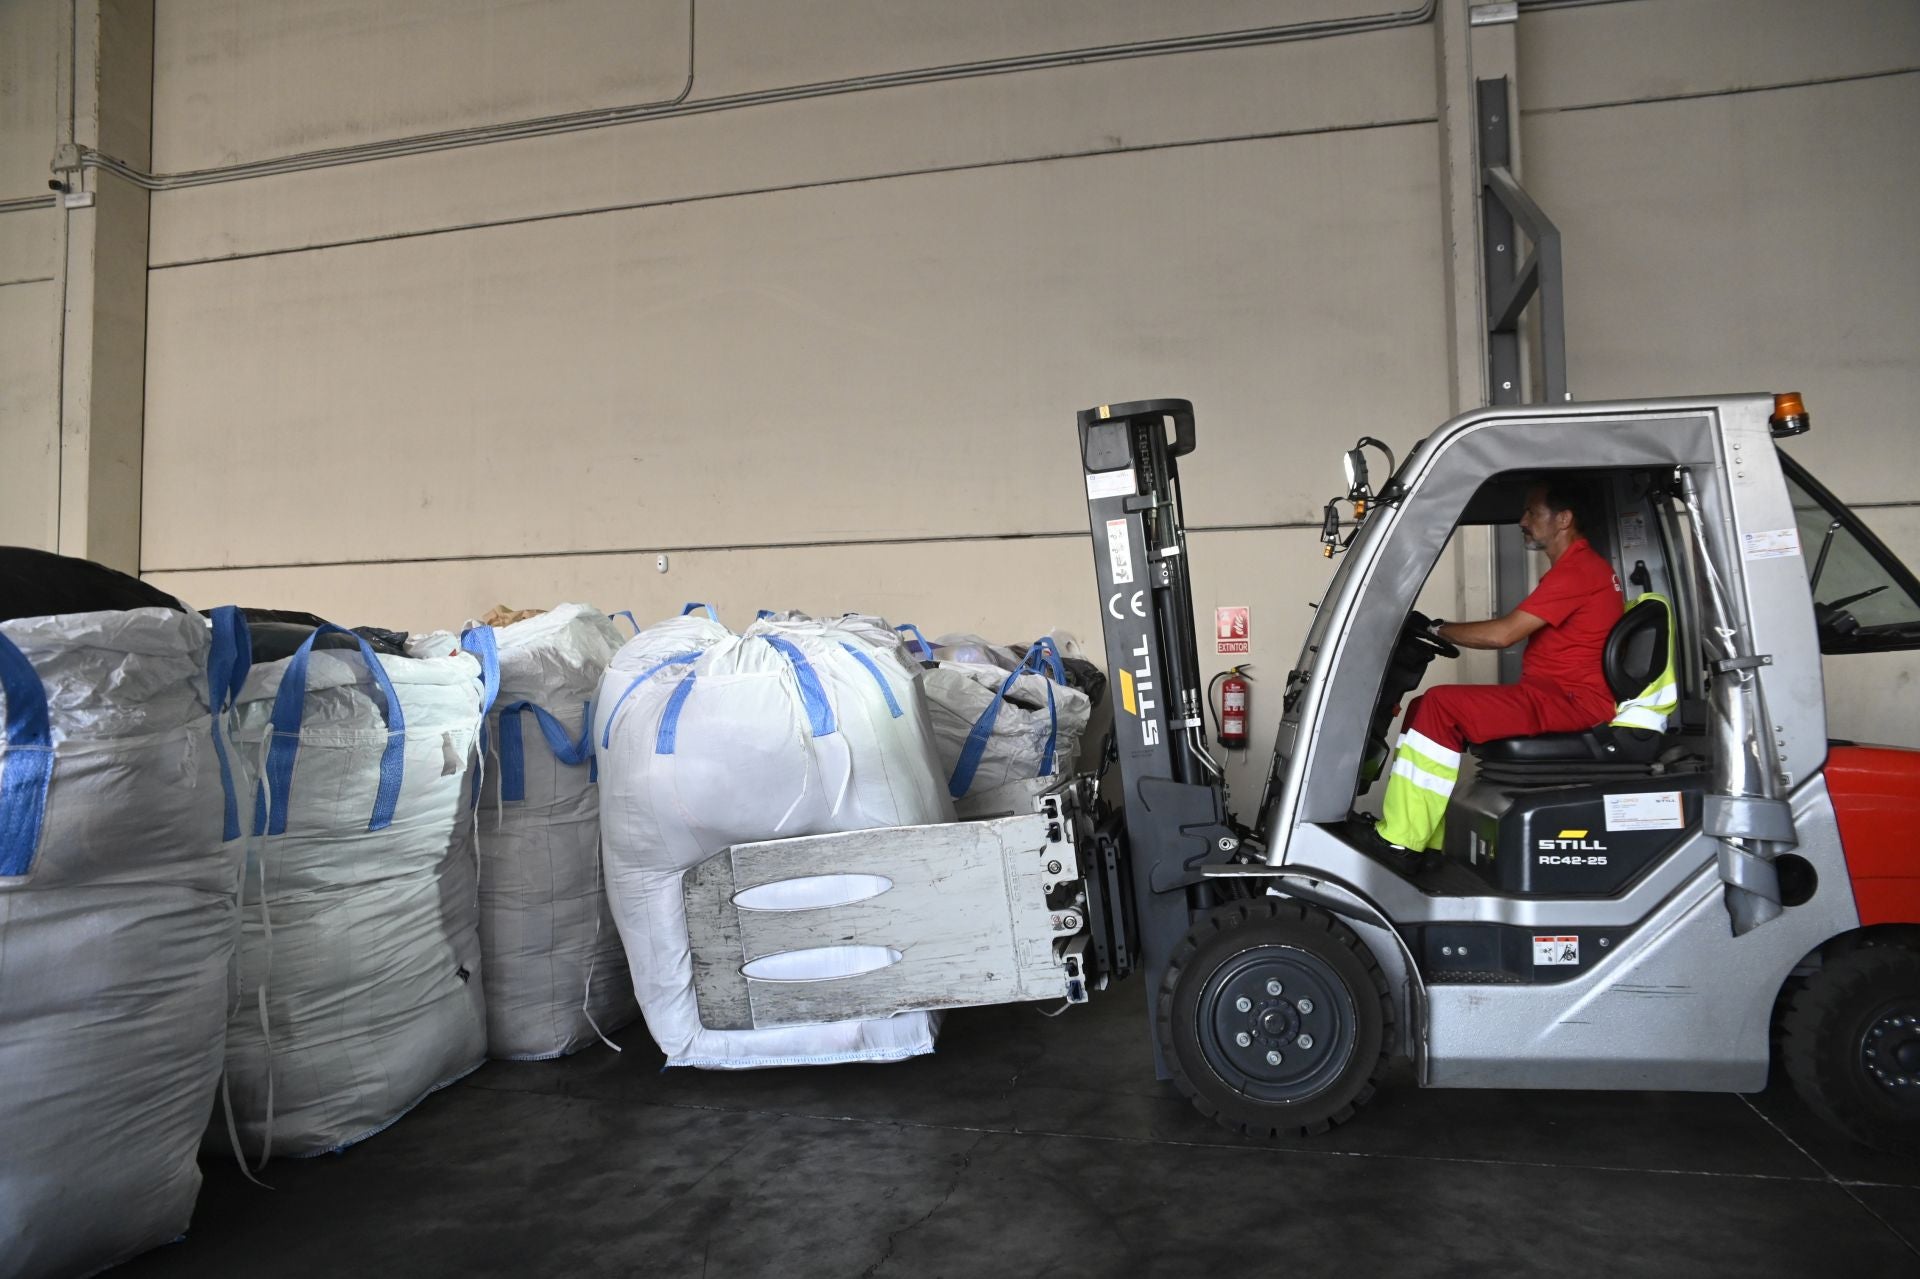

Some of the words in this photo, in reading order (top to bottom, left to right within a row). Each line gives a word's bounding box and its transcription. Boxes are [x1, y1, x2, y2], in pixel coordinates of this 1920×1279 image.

[1108, 590, 1146, 620] CE
[1218, 642, 1248, 652] EXTINTOR
[1132, 634, 1160, 746] STILL
[1538, 839, 1607, 850] STILL
[1538, 855, 1608, 865] RC42-25
